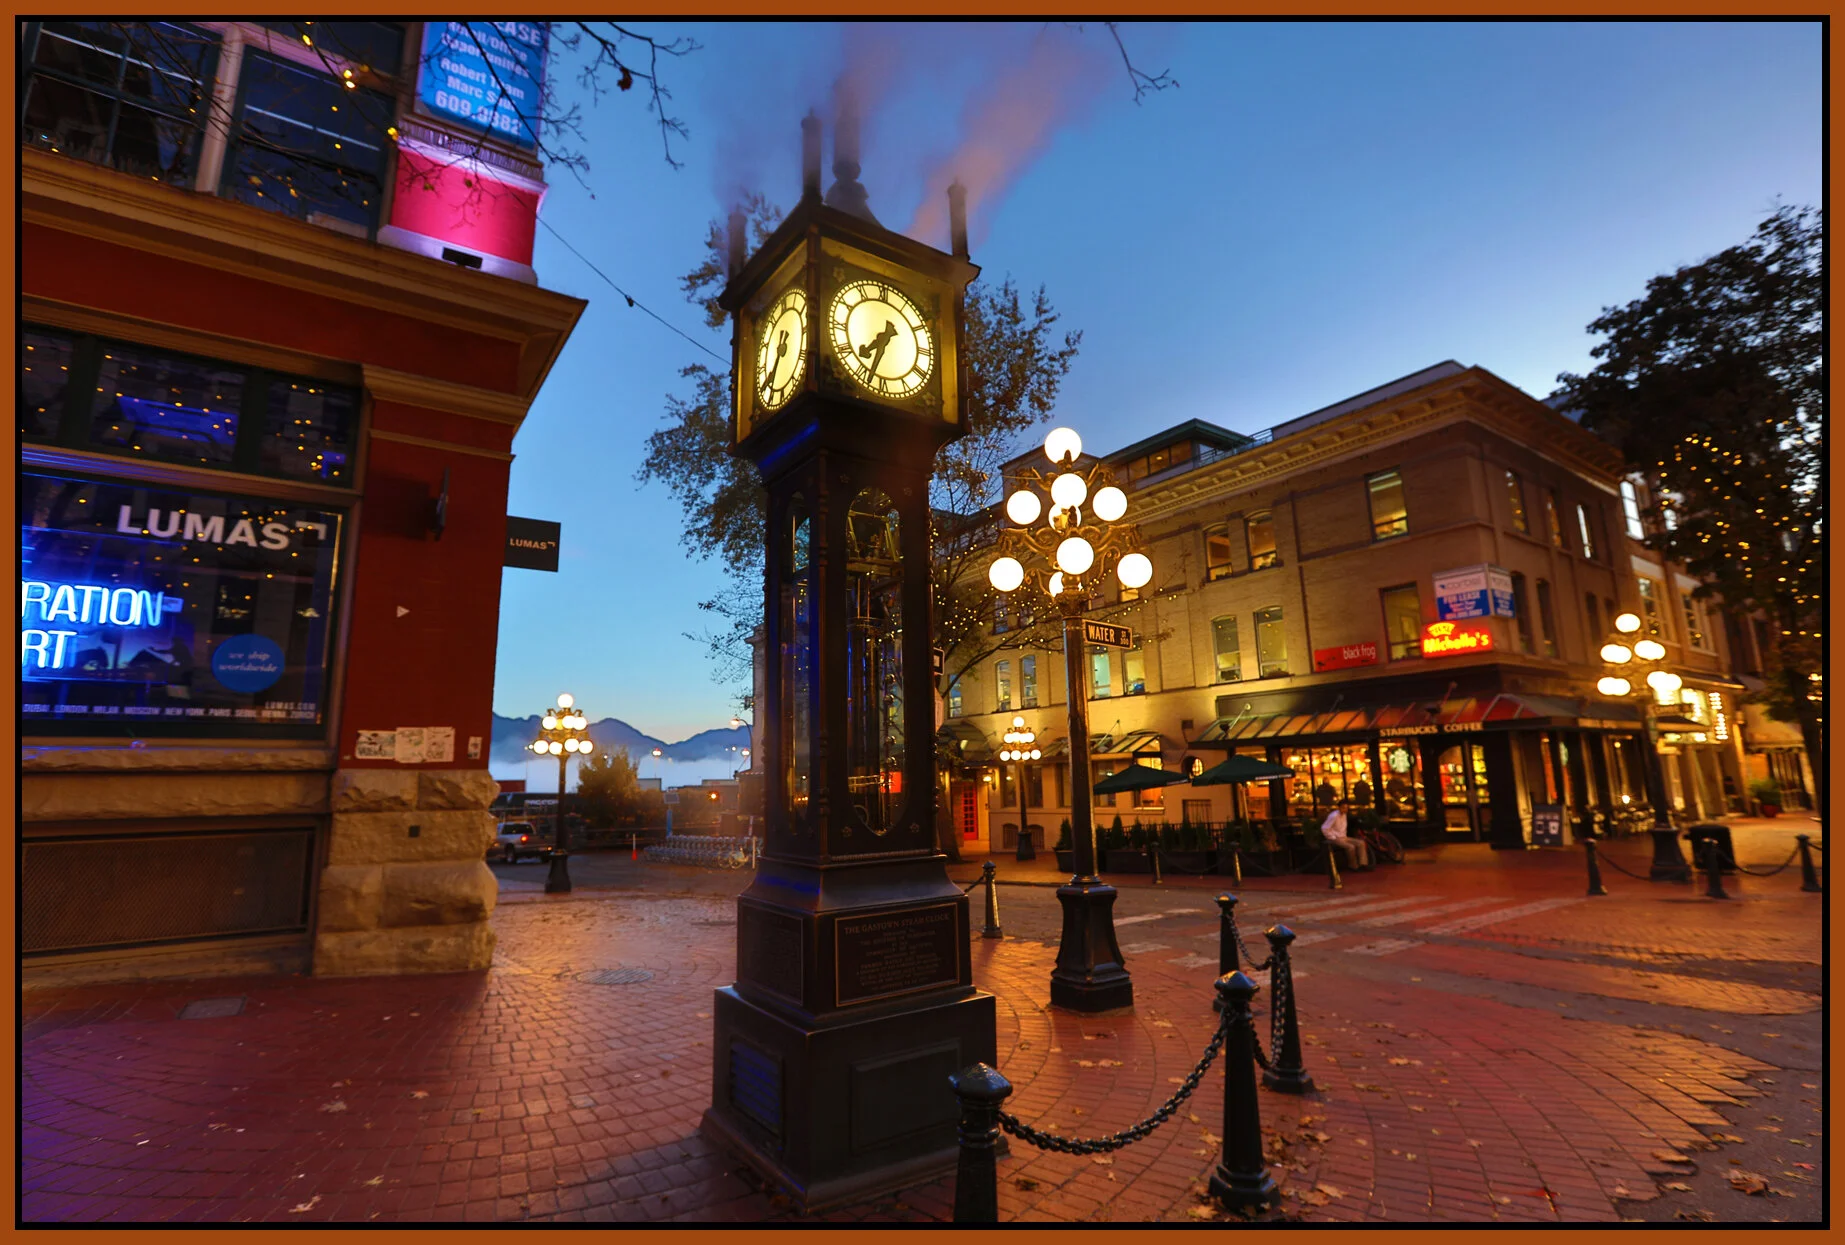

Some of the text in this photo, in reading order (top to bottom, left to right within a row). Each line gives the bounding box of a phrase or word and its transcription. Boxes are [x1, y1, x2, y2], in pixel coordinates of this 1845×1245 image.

[488, 22, 540, 46] EASE
[441, 57, 487, 84] Robert
[447, 75, 484, 99] Marc
[116, 504, 291, 551] LUMAS
[509, 538, 548, 550] LUMAS
[1088, 625, 1115, 643] WATER
[1423, 632, 1489, 653] Michelle's
[1343, 643, 1376, 660] black frog
[1380, 721, 1483, 737] STARBUCKS COFFEE
